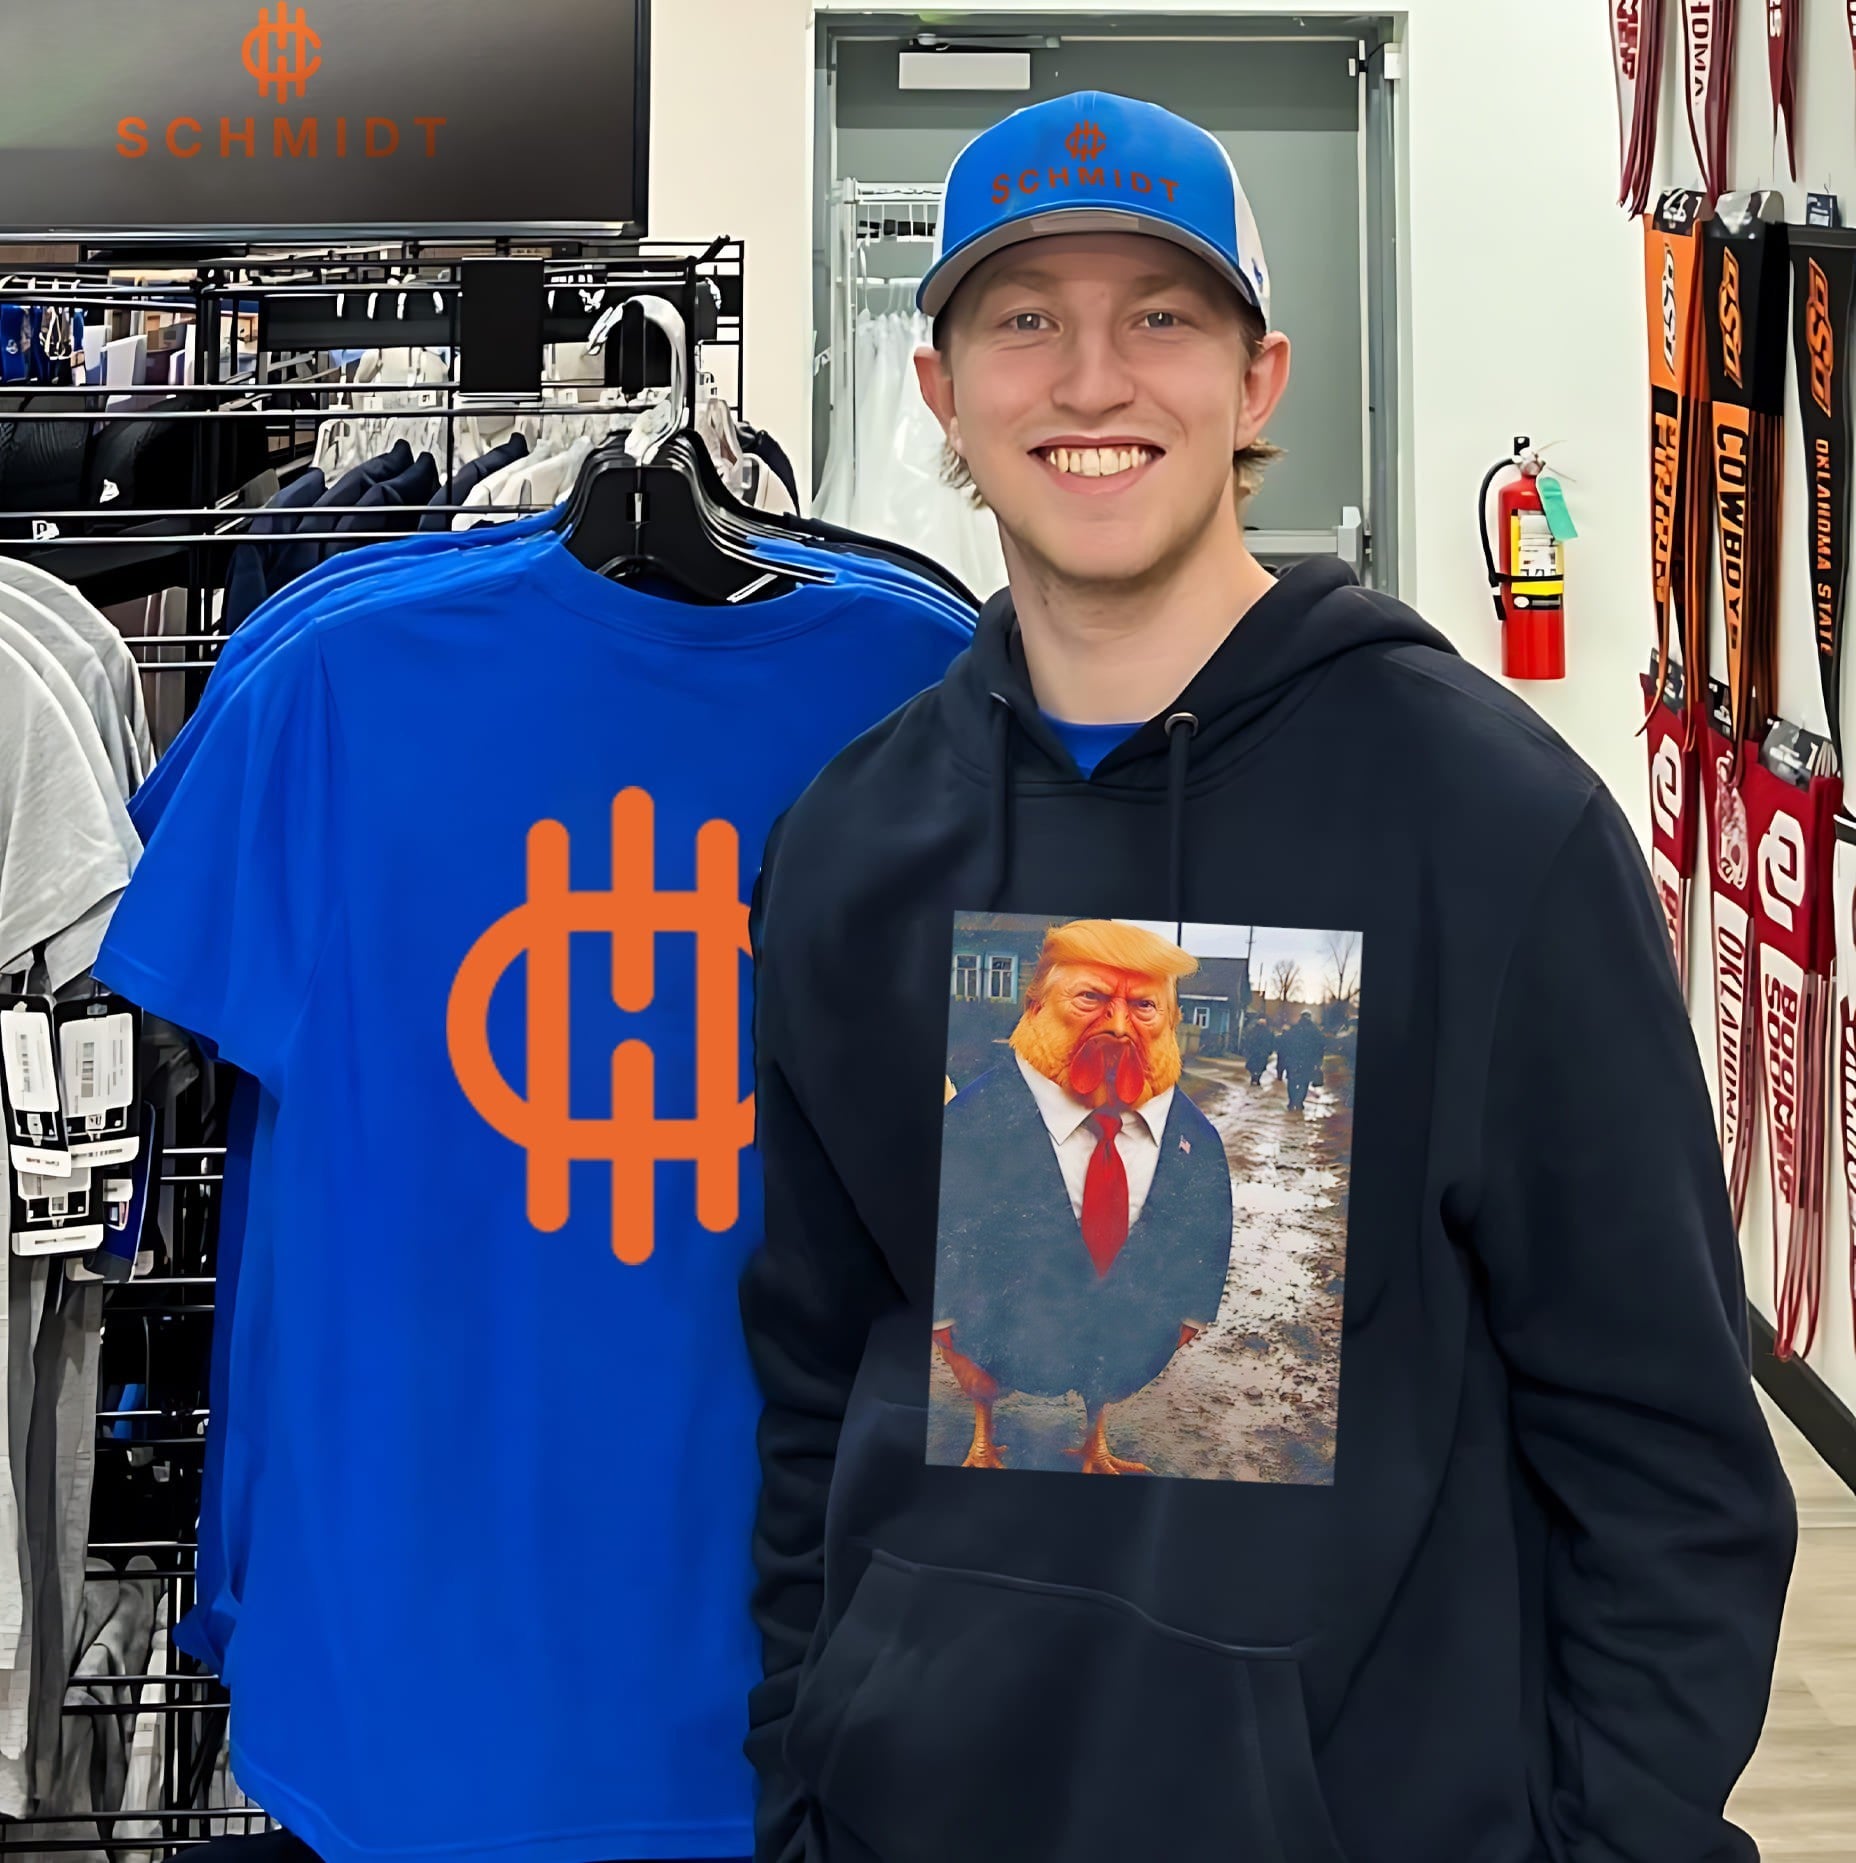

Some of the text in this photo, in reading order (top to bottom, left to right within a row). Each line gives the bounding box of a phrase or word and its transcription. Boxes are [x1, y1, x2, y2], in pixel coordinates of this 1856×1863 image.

[115, 117, 448, 158] SCHMIDT
[991, 167, 1179, 204] SCHMIDT
[1815, 439, 1833, 656] OKLAHOMA STATE
[1718, 926, 1745, 1143] OKLAHOMA
